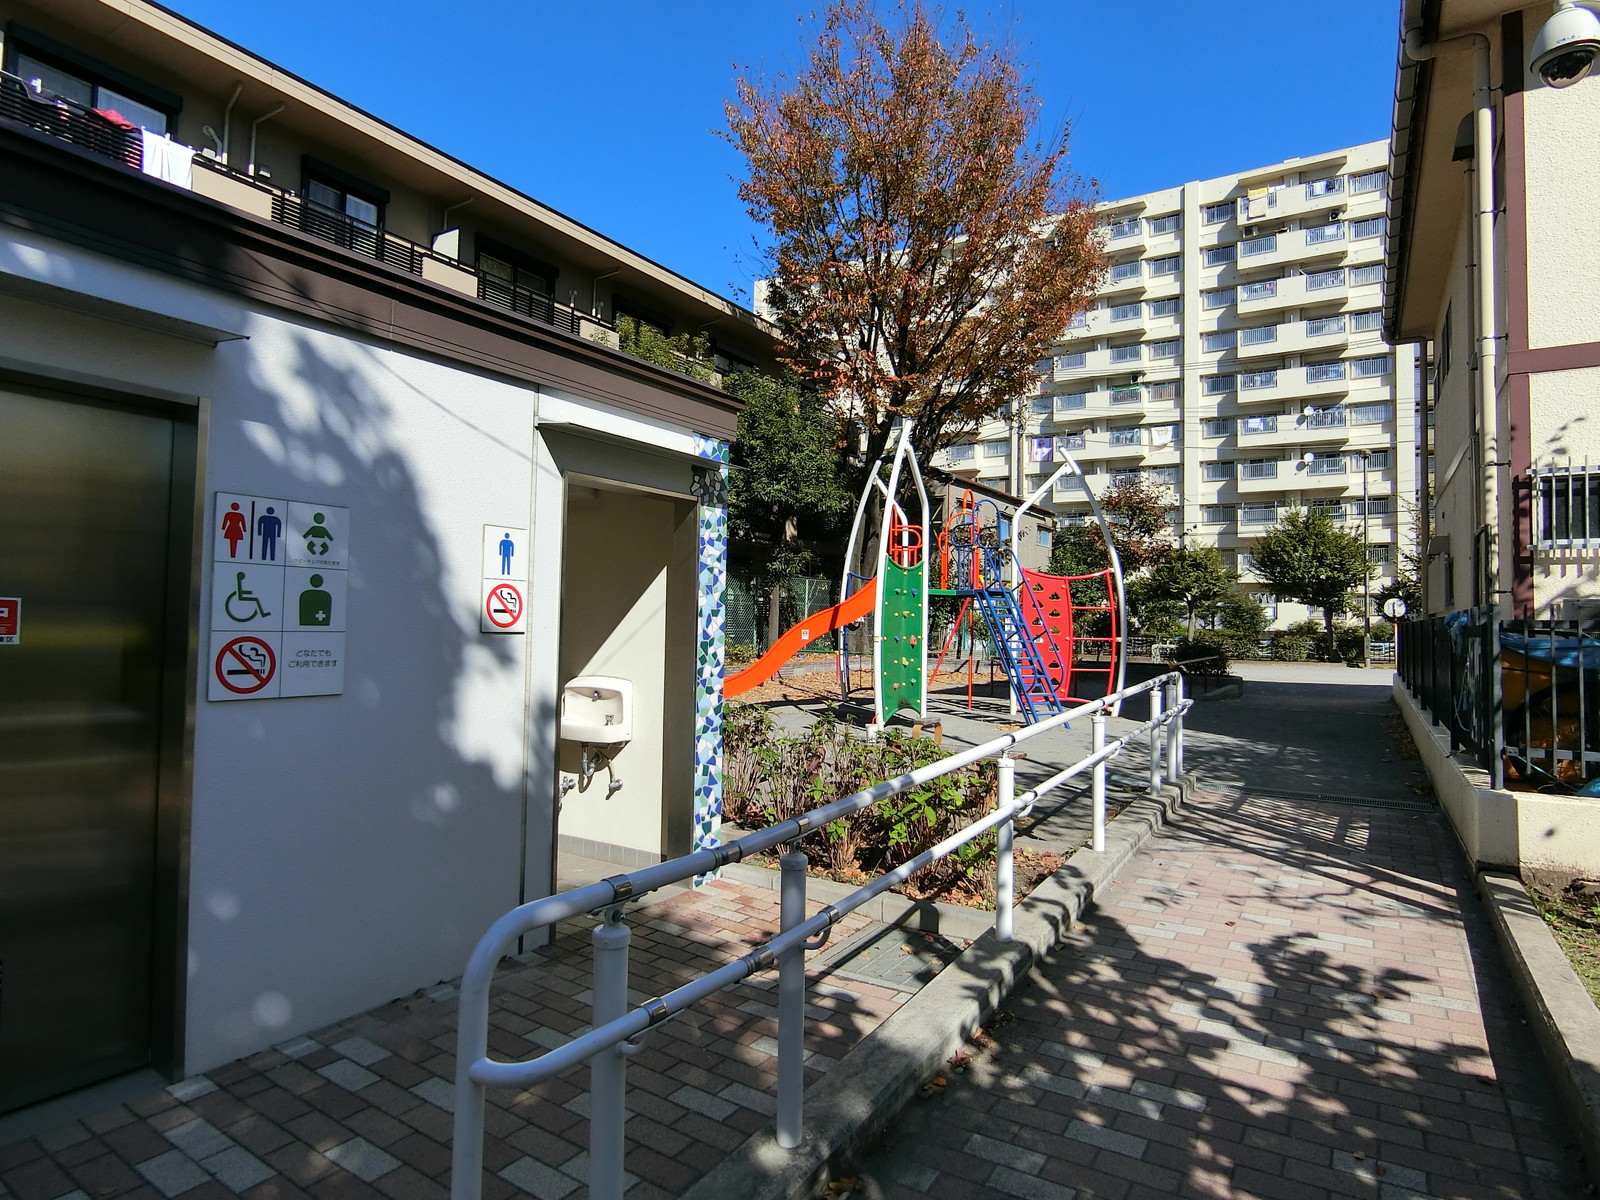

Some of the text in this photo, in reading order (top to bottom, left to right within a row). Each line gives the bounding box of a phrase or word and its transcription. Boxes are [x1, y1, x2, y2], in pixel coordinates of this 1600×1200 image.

[296, 649, 332, 657] どなたでも
[288, 659, 338, 668] ご利用できます
